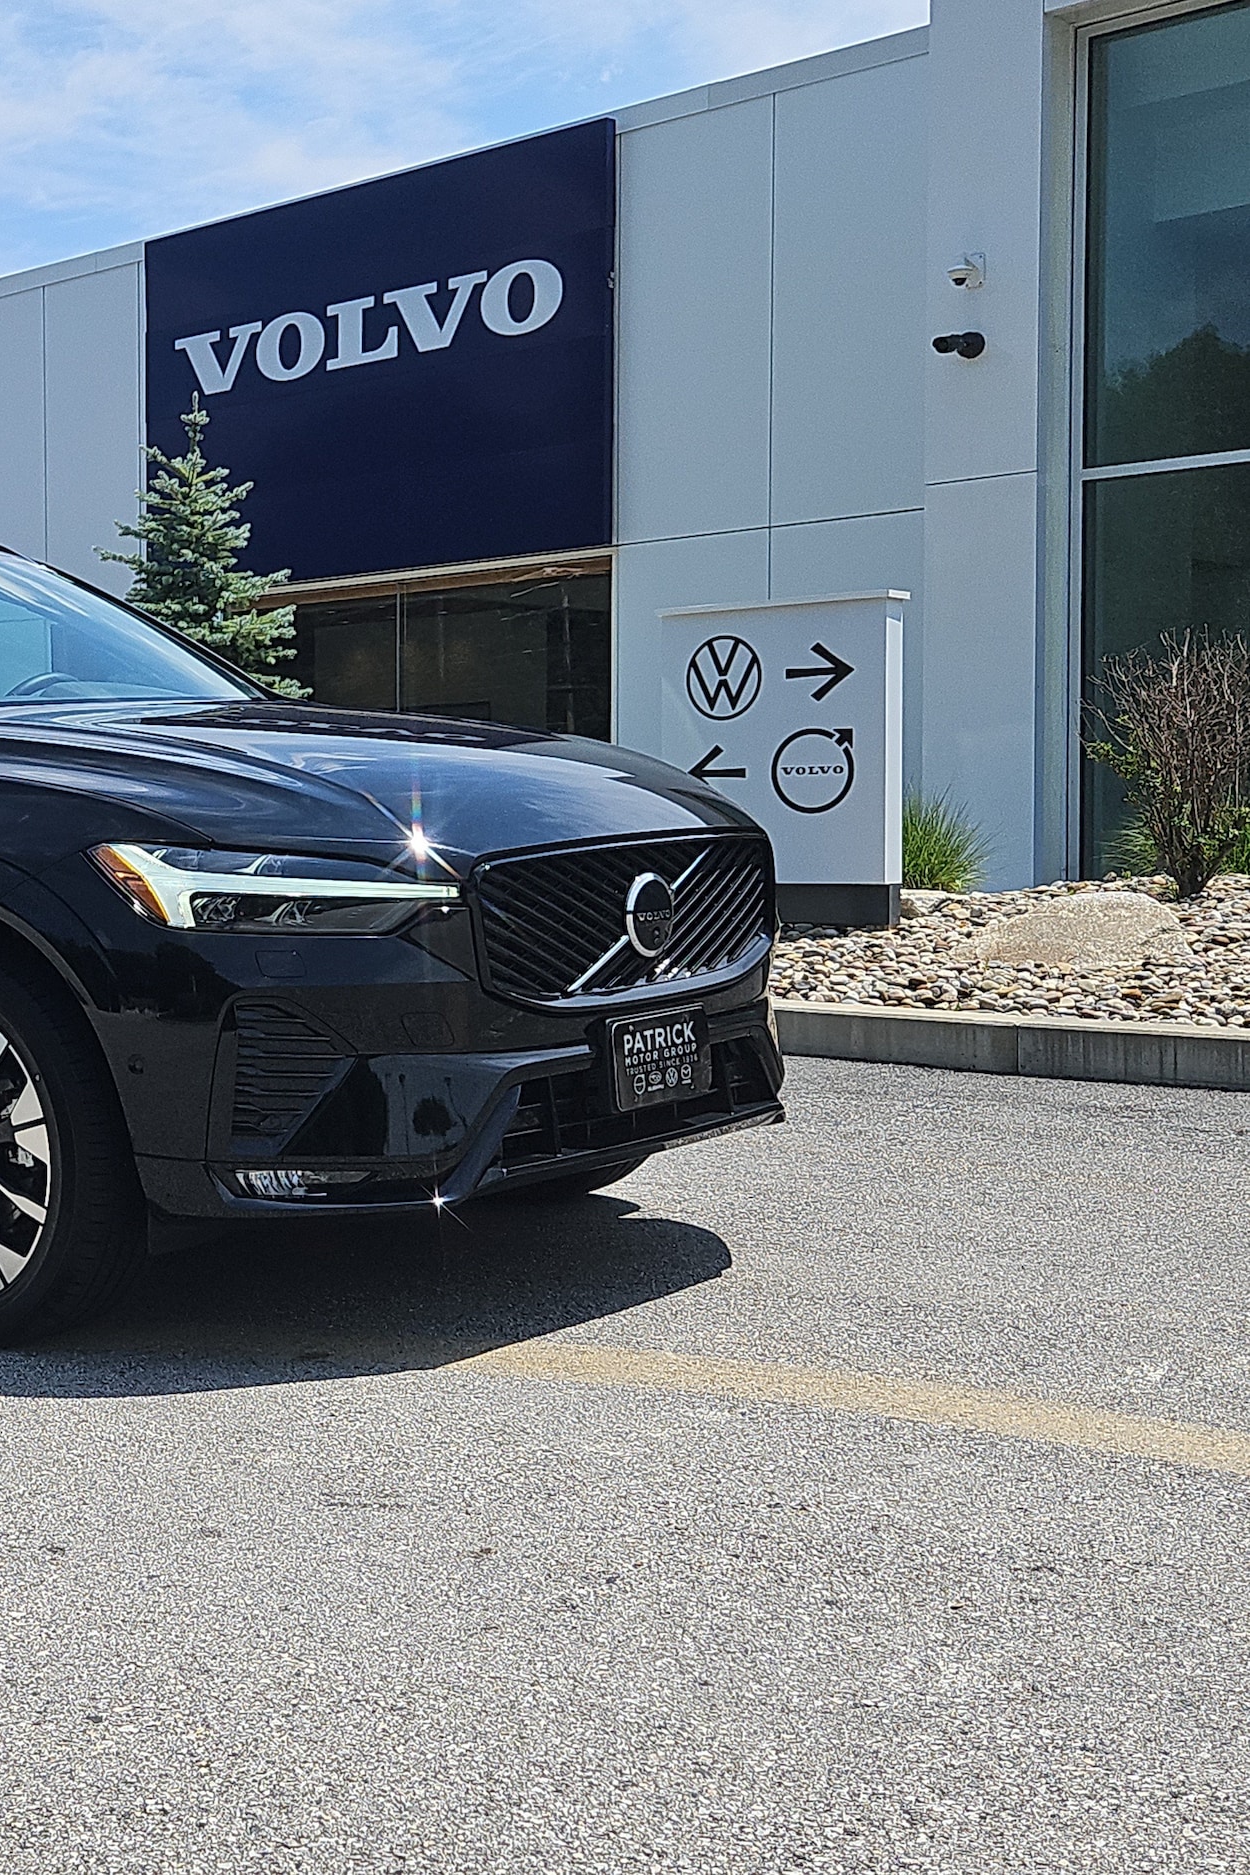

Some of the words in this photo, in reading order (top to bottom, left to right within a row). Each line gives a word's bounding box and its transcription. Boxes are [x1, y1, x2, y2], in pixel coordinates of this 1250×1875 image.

[174, 259, 563, 395] VOLVO
[781, 764, 844, 776] VOLVO
[636, 909, 671, 921] VOLVO
[623, 1021, 696, 1055] PATRICK
[625, 1051, 659, 1067] MOTOR
[663, 1043, 697, 1058] GROUP
[626, 1063, 657, 1076] TRUSTED
[659, 1057, 681, 1069] SINCE
